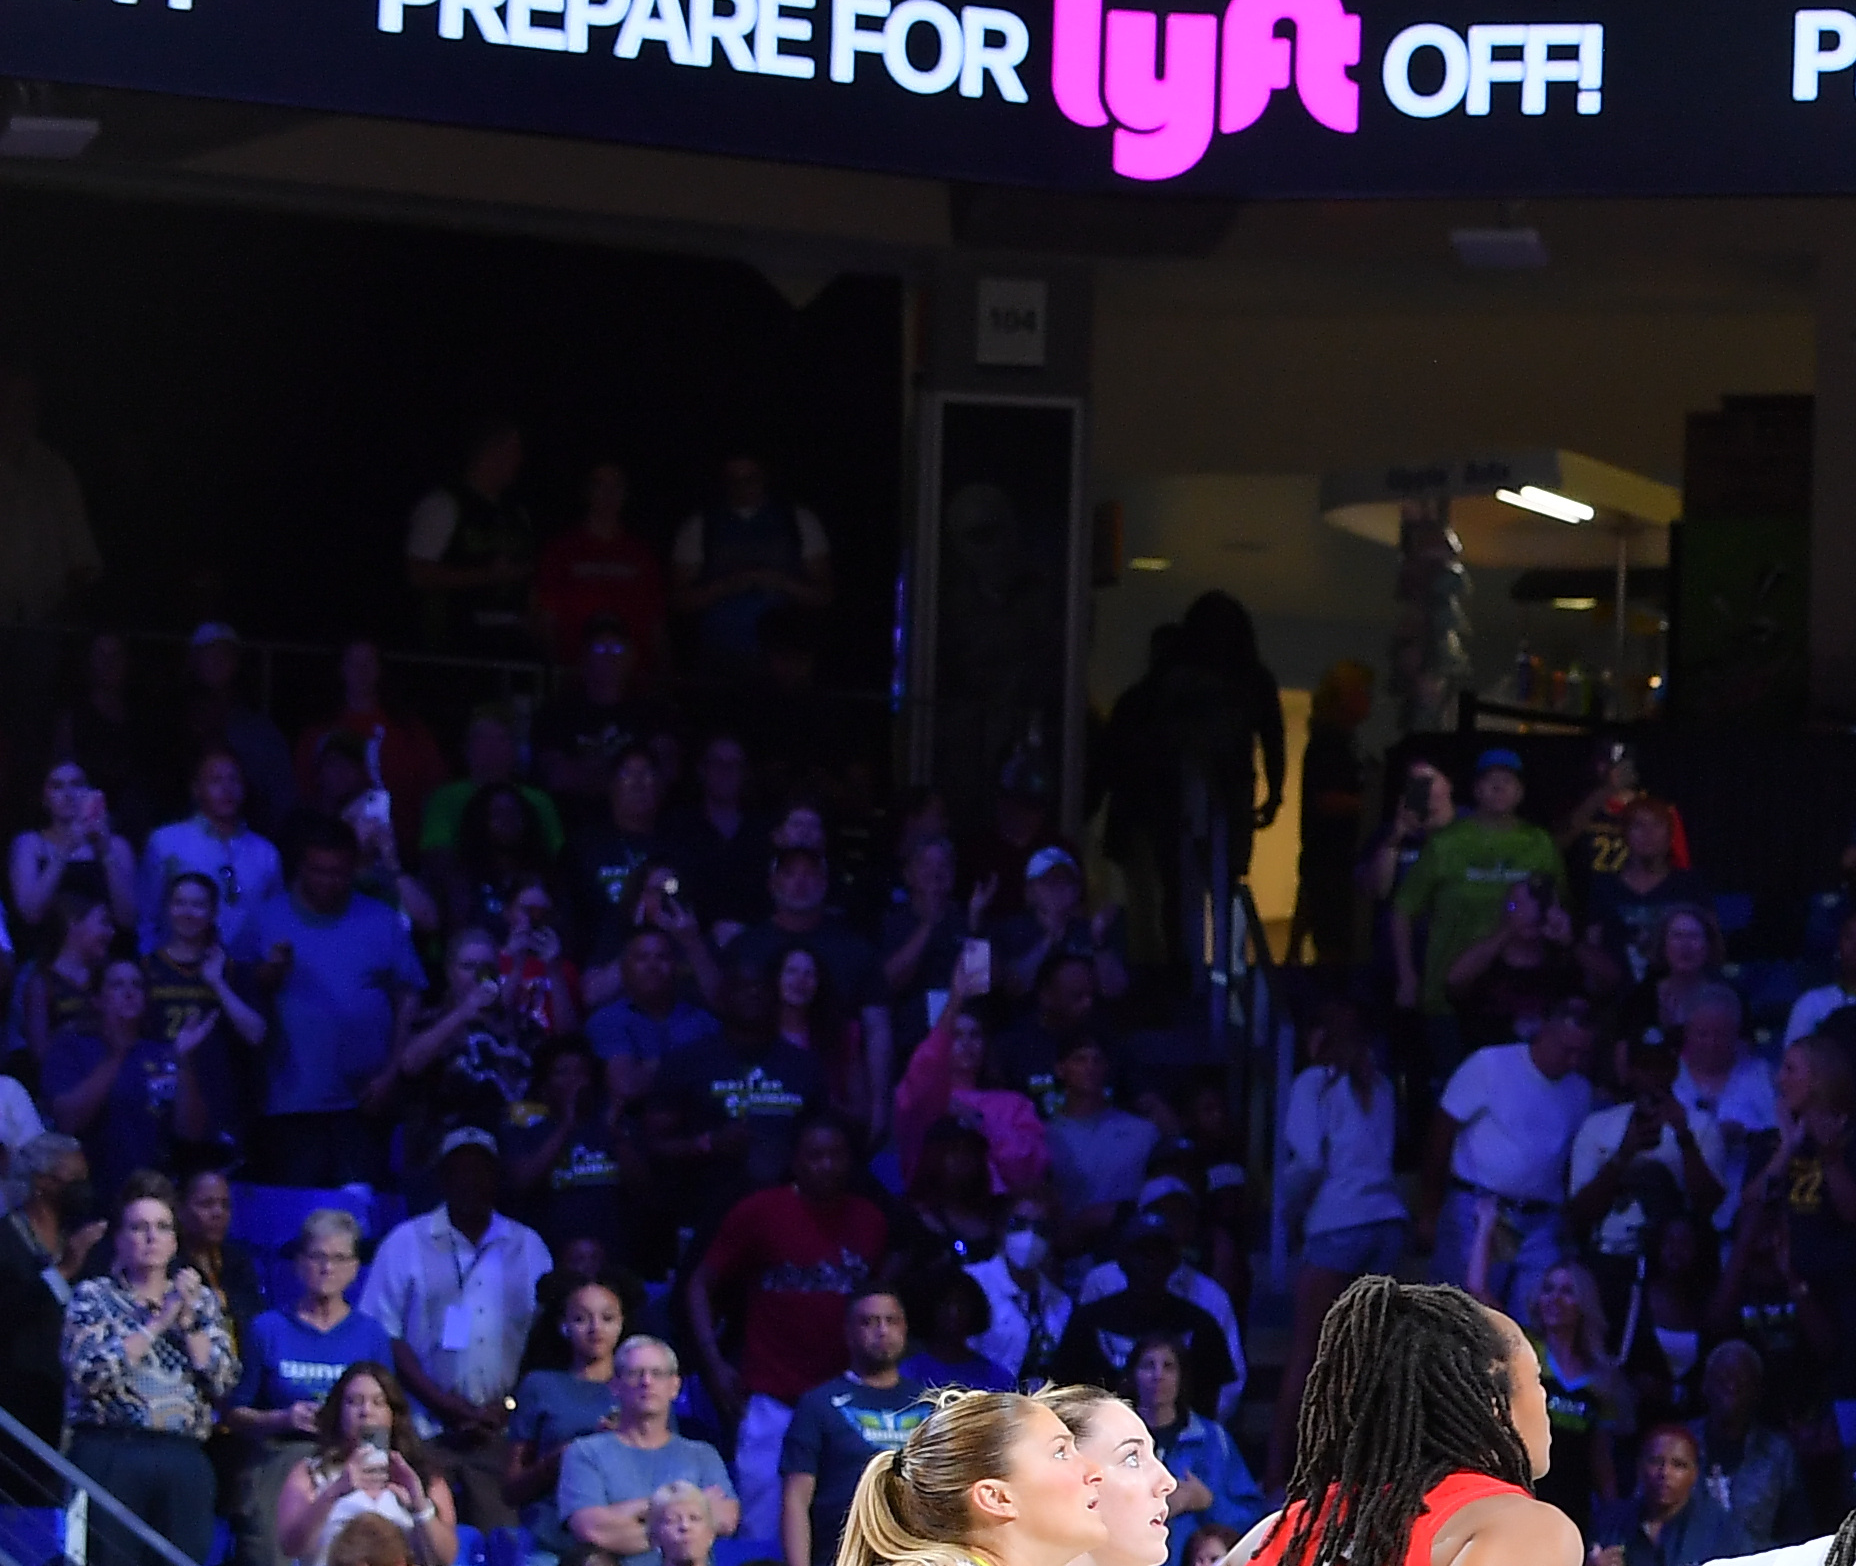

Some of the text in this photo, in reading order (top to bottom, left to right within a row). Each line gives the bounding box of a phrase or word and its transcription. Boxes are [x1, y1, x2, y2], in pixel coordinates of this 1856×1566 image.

[829, 0, 1028, 104] FOR
[1050, 0, 1362, 181] lyft
[1383, 22, 1604, 118] OFF!
